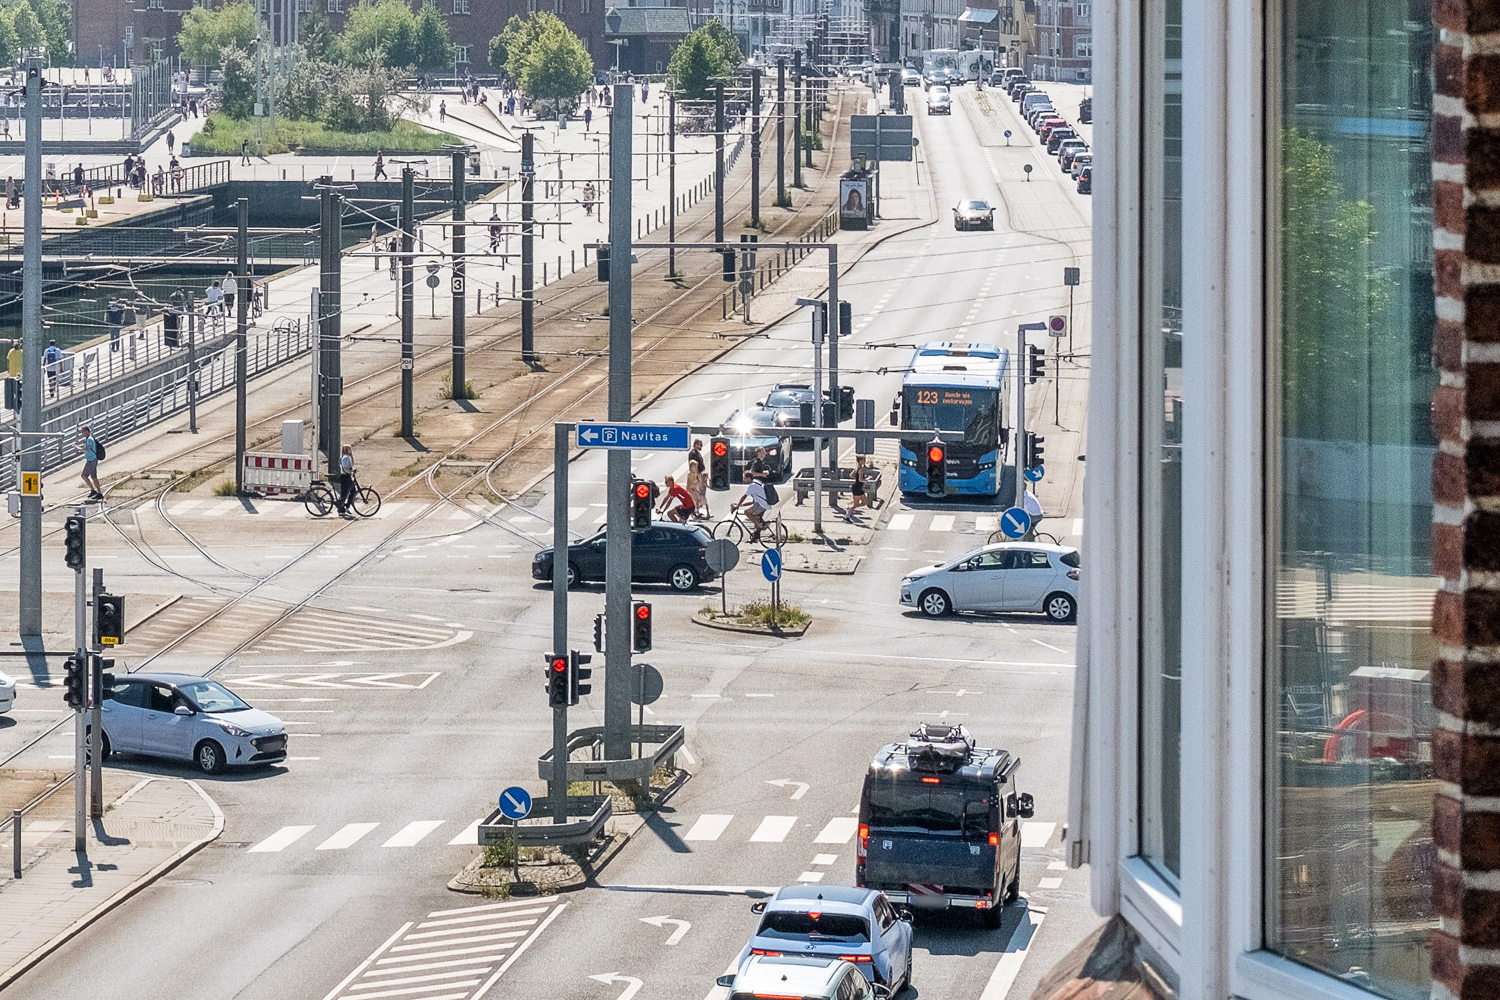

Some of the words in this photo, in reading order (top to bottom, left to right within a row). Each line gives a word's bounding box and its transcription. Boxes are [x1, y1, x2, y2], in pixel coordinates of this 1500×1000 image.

[453, 279, 462, 291] 3
[917, 390, 939, 404] 123
[621, 431, 668, 442] Navitas
